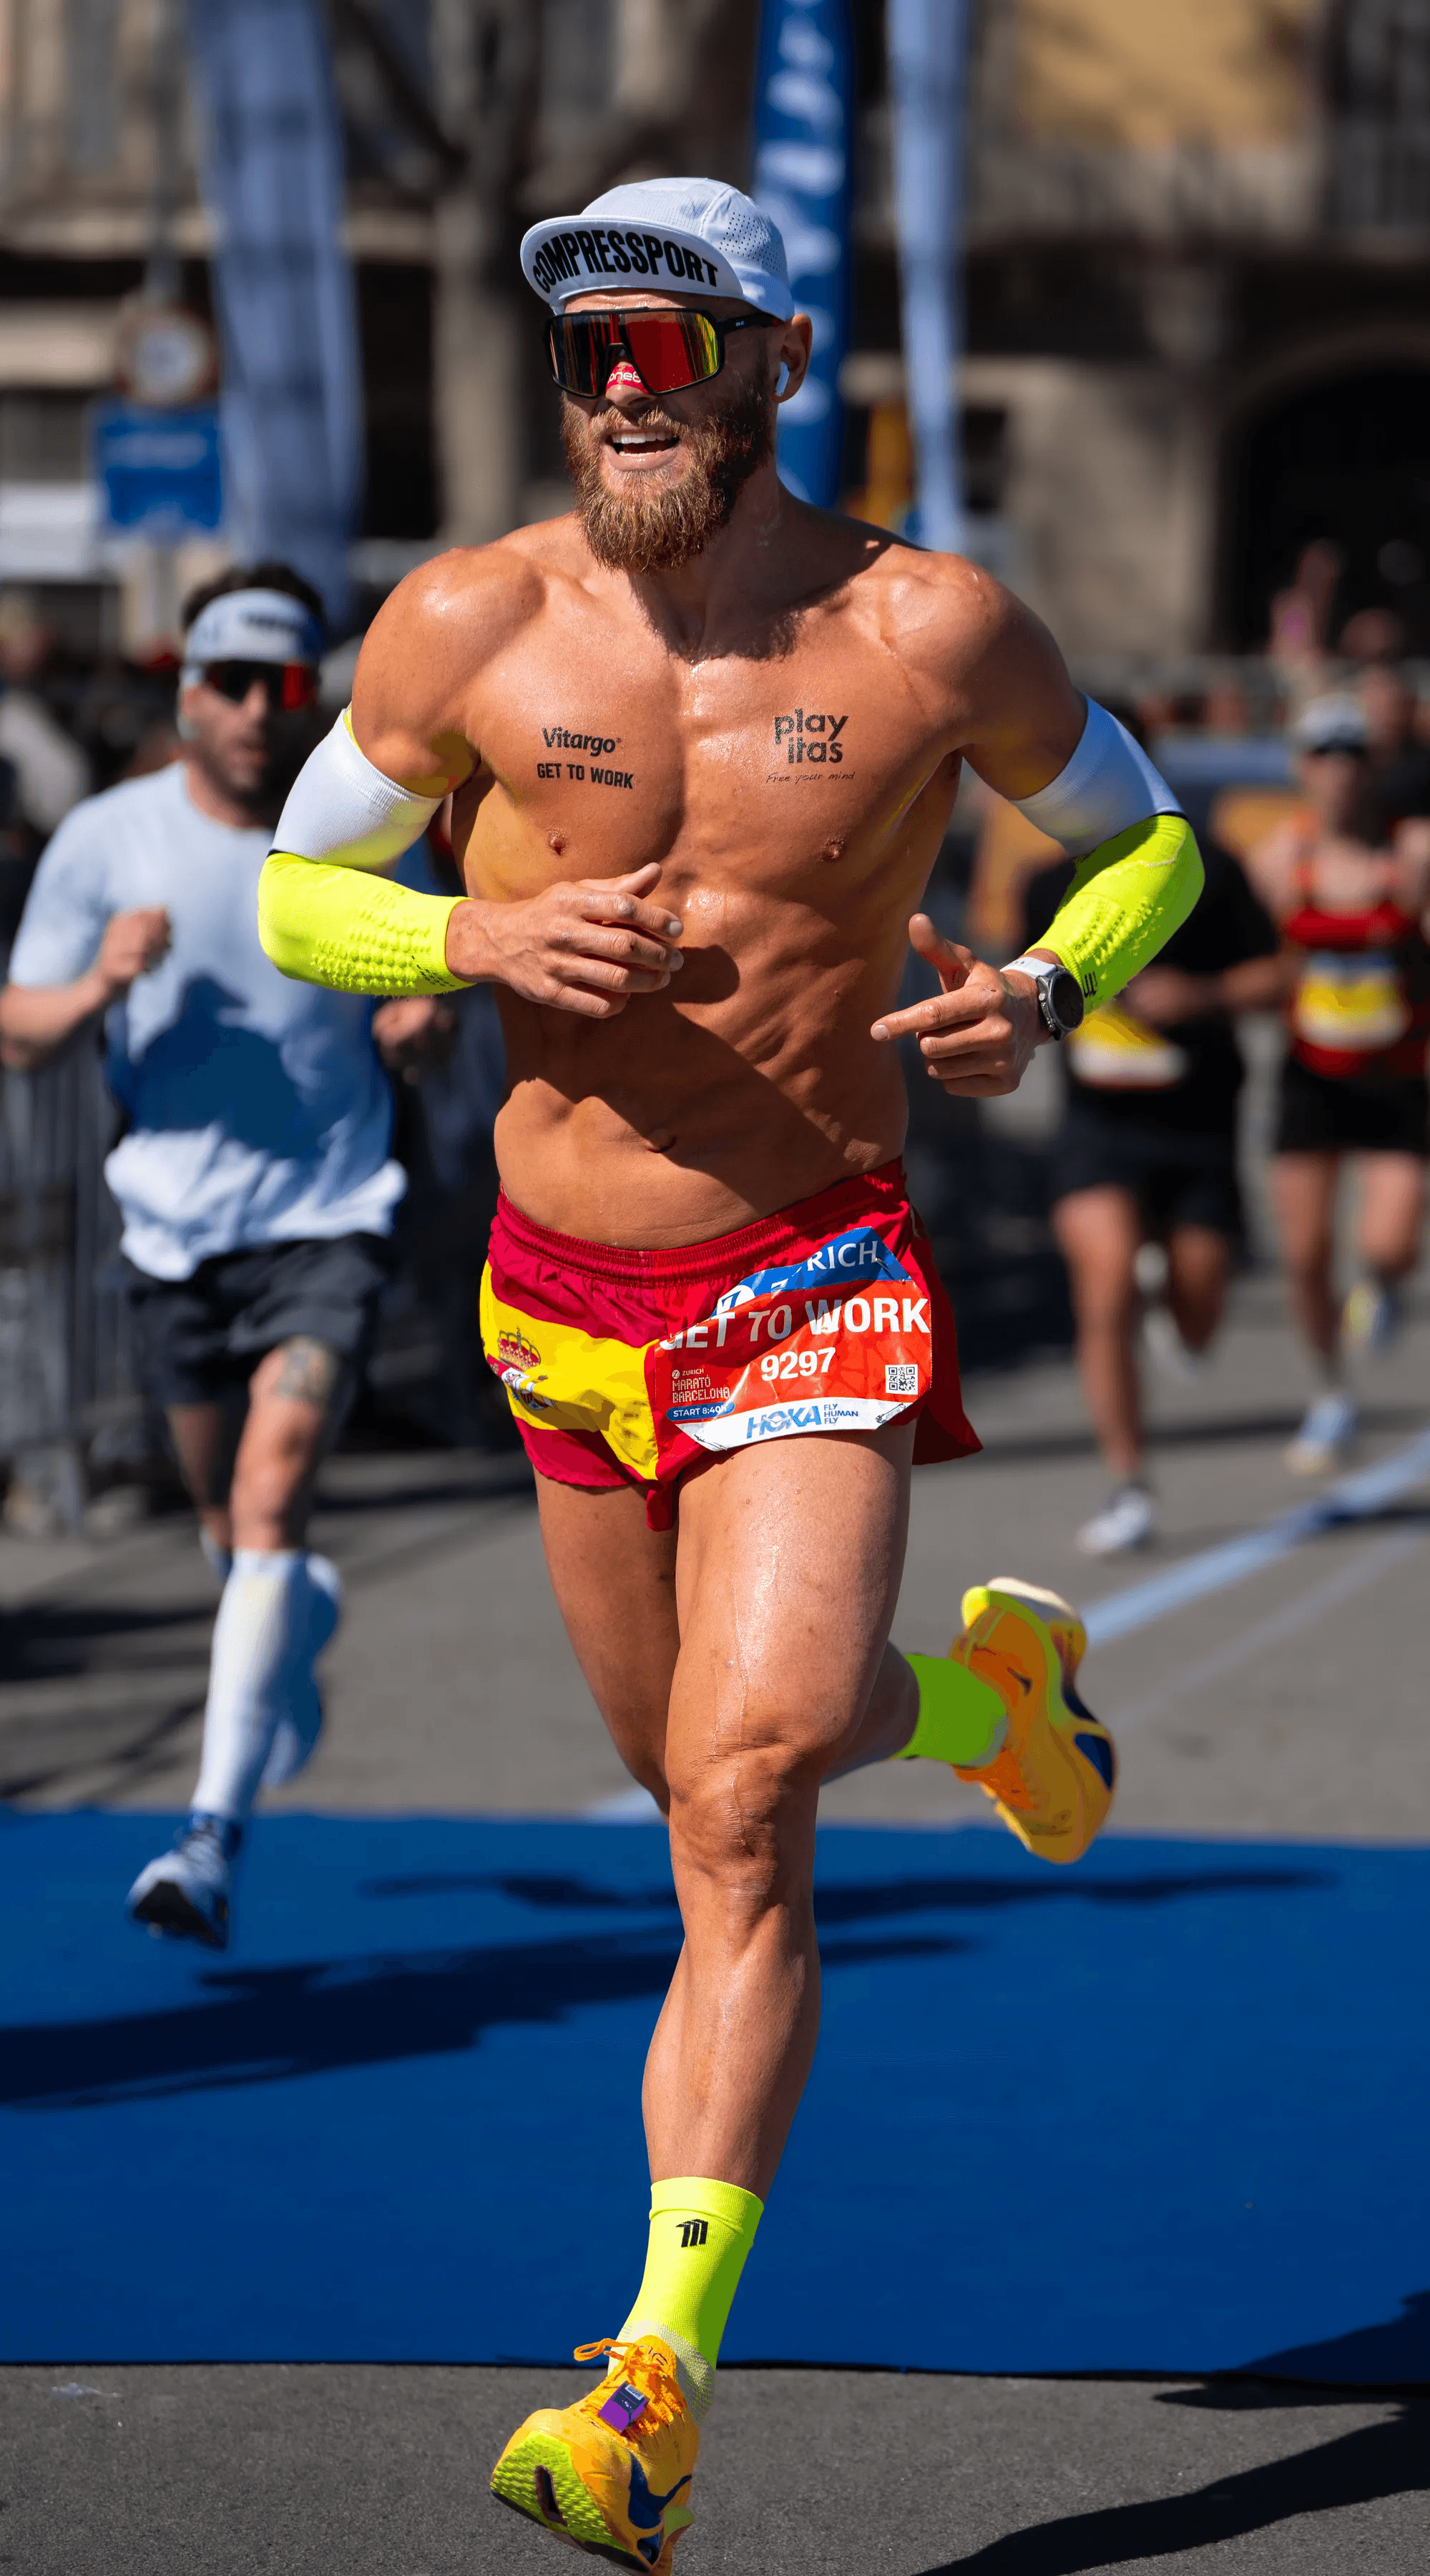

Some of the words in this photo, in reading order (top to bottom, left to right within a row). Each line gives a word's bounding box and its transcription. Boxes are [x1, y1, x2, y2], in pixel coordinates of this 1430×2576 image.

[532, 229, 718, 293] COMPRESSPORT
[775, 708, 849, 744] play
[788, 736, 843, 763] itas
[537, 763, 562, 779] GET
[567, 763, 584, 781] TO
[590, 766, 634, 789] WORK
[766, 772, 790, 784] Free
[795, 774, 823, 785] your
[828, 771, 856, 780] mind
[748, 1304, 793, 1342] TO
[804, 1297, 931, 1335] WORK
[760, 1347, 836, 1382] 9297
[672, 1374, 711, 1392] MARATÓ
[672, 1387, 730, 1403] BARCELONA
[673, 1407, 700, 1418] START
[746, 1405, 822, 1439] HOKA
